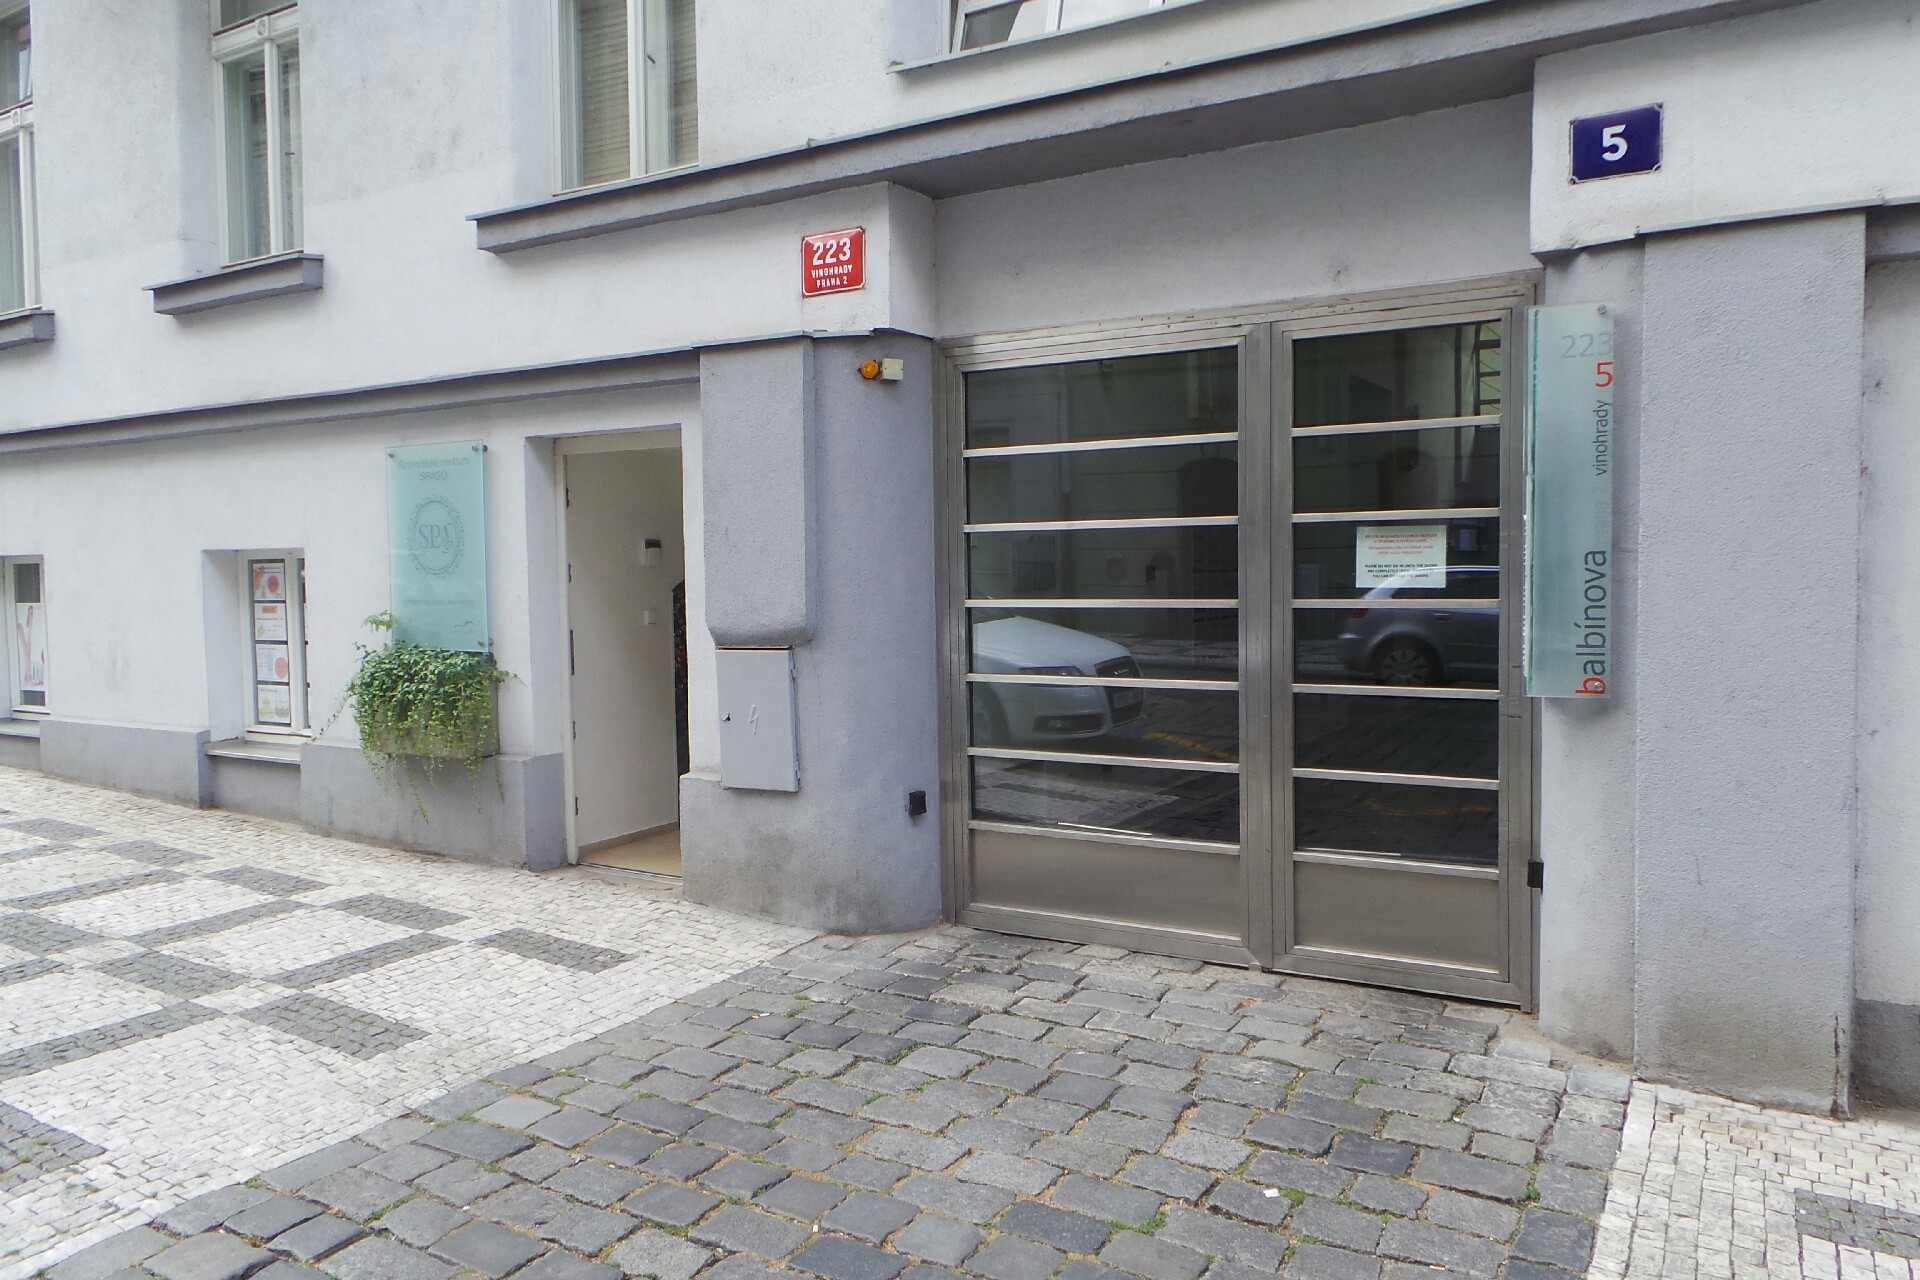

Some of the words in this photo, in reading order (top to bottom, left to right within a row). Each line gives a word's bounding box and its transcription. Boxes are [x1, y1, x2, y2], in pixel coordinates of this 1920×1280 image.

[1602, 124, 1628, 161] 5
[812, 237, 851, 266] 223
[811, 264, 853, 279] VINOHRADY
[816, 276, 841, 289] PRAHA
[842, 275, 848, 285] 2
[1560, 332, 1614, 359] 223
[1595, 361, 1615, 388] 5
[1592, 399, 1612, 477] vinohrady
[1574, 550, 1607, 695] balbínova
